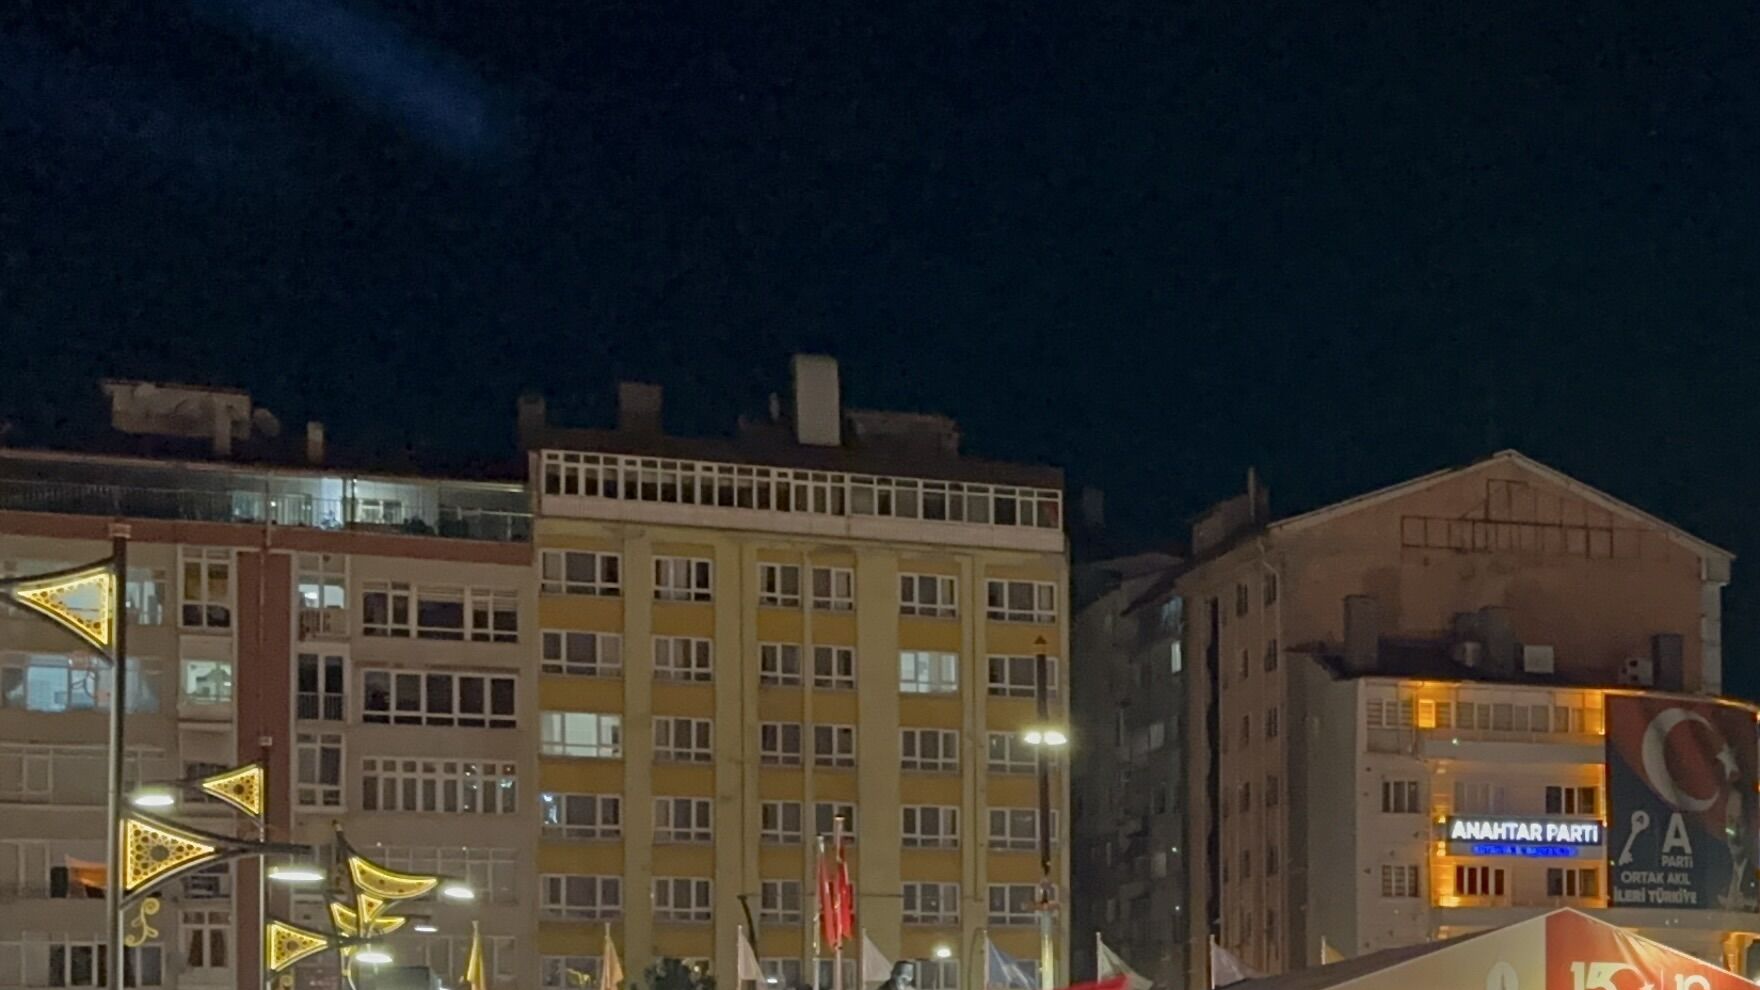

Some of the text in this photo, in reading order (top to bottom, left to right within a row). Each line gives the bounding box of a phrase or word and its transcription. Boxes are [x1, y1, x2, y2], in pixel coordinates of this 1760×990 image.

[1451, 820, 1599, 843] ANAHTAR PARTİ
[1662, 812, 1693, 854] A
[1661, 855, 1694, 868] PARTİ
[1620, 870, 1664, 884] ORTAK
[1614, 885, 1697, 904] İLERİ TÜRKİYE
